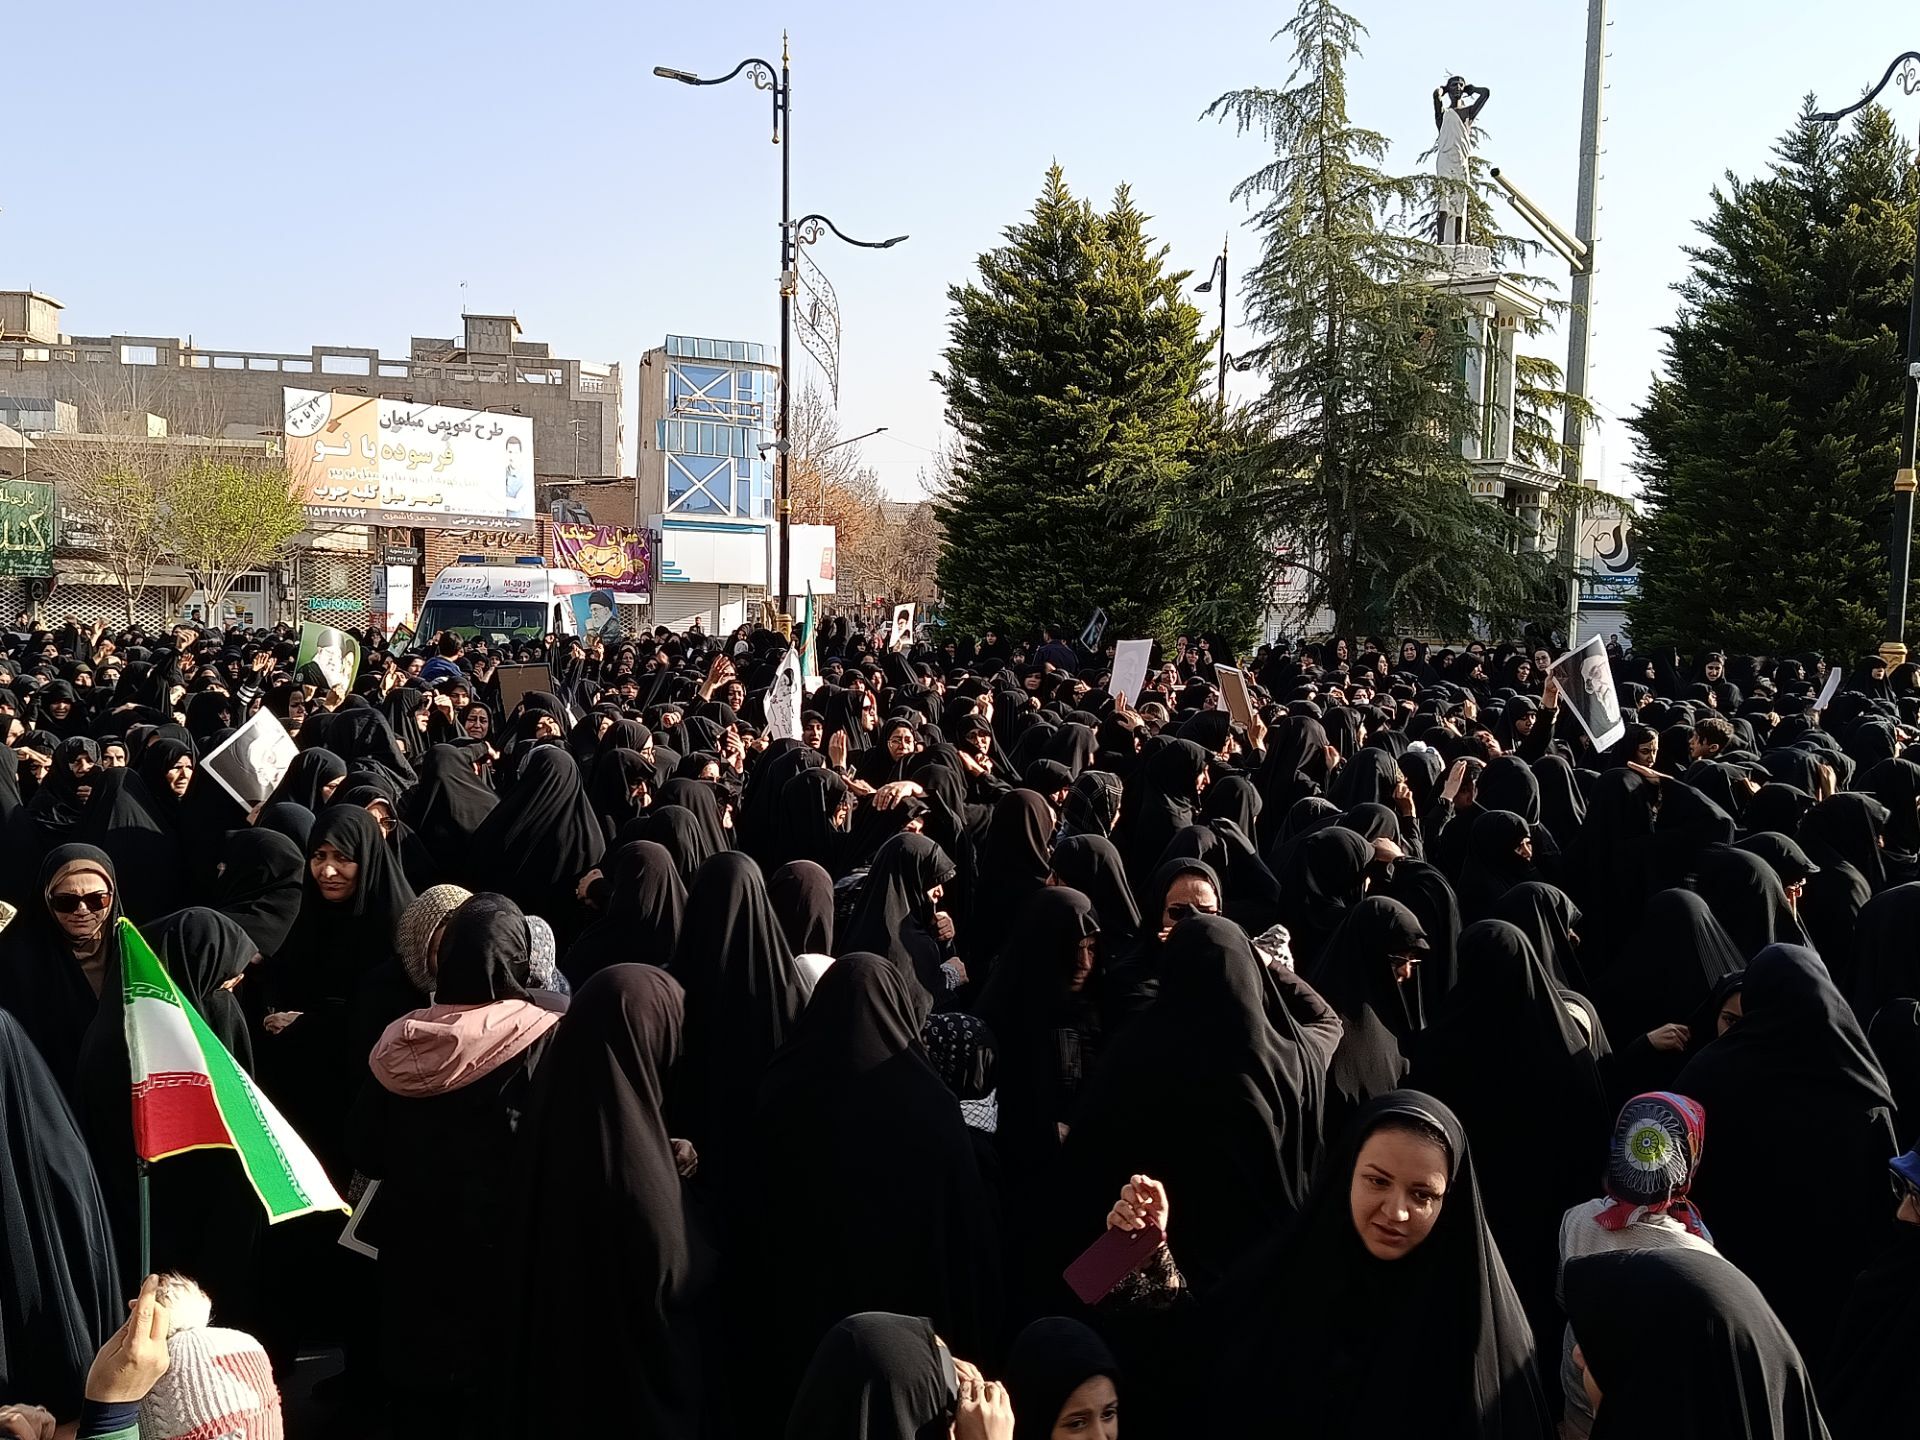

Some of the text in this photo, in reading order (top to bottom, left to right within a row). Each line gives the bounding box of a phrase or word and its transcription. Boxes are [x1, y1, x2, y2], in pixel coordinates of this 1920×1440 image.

[379, 409, 504, 441] طرح تعویض مبلمان
[312, 432, 455, 472] فرسوده با نو
[561, 524, 645, 548] زعفران خشکبا
[503, 579, 531, 588] M-3013
